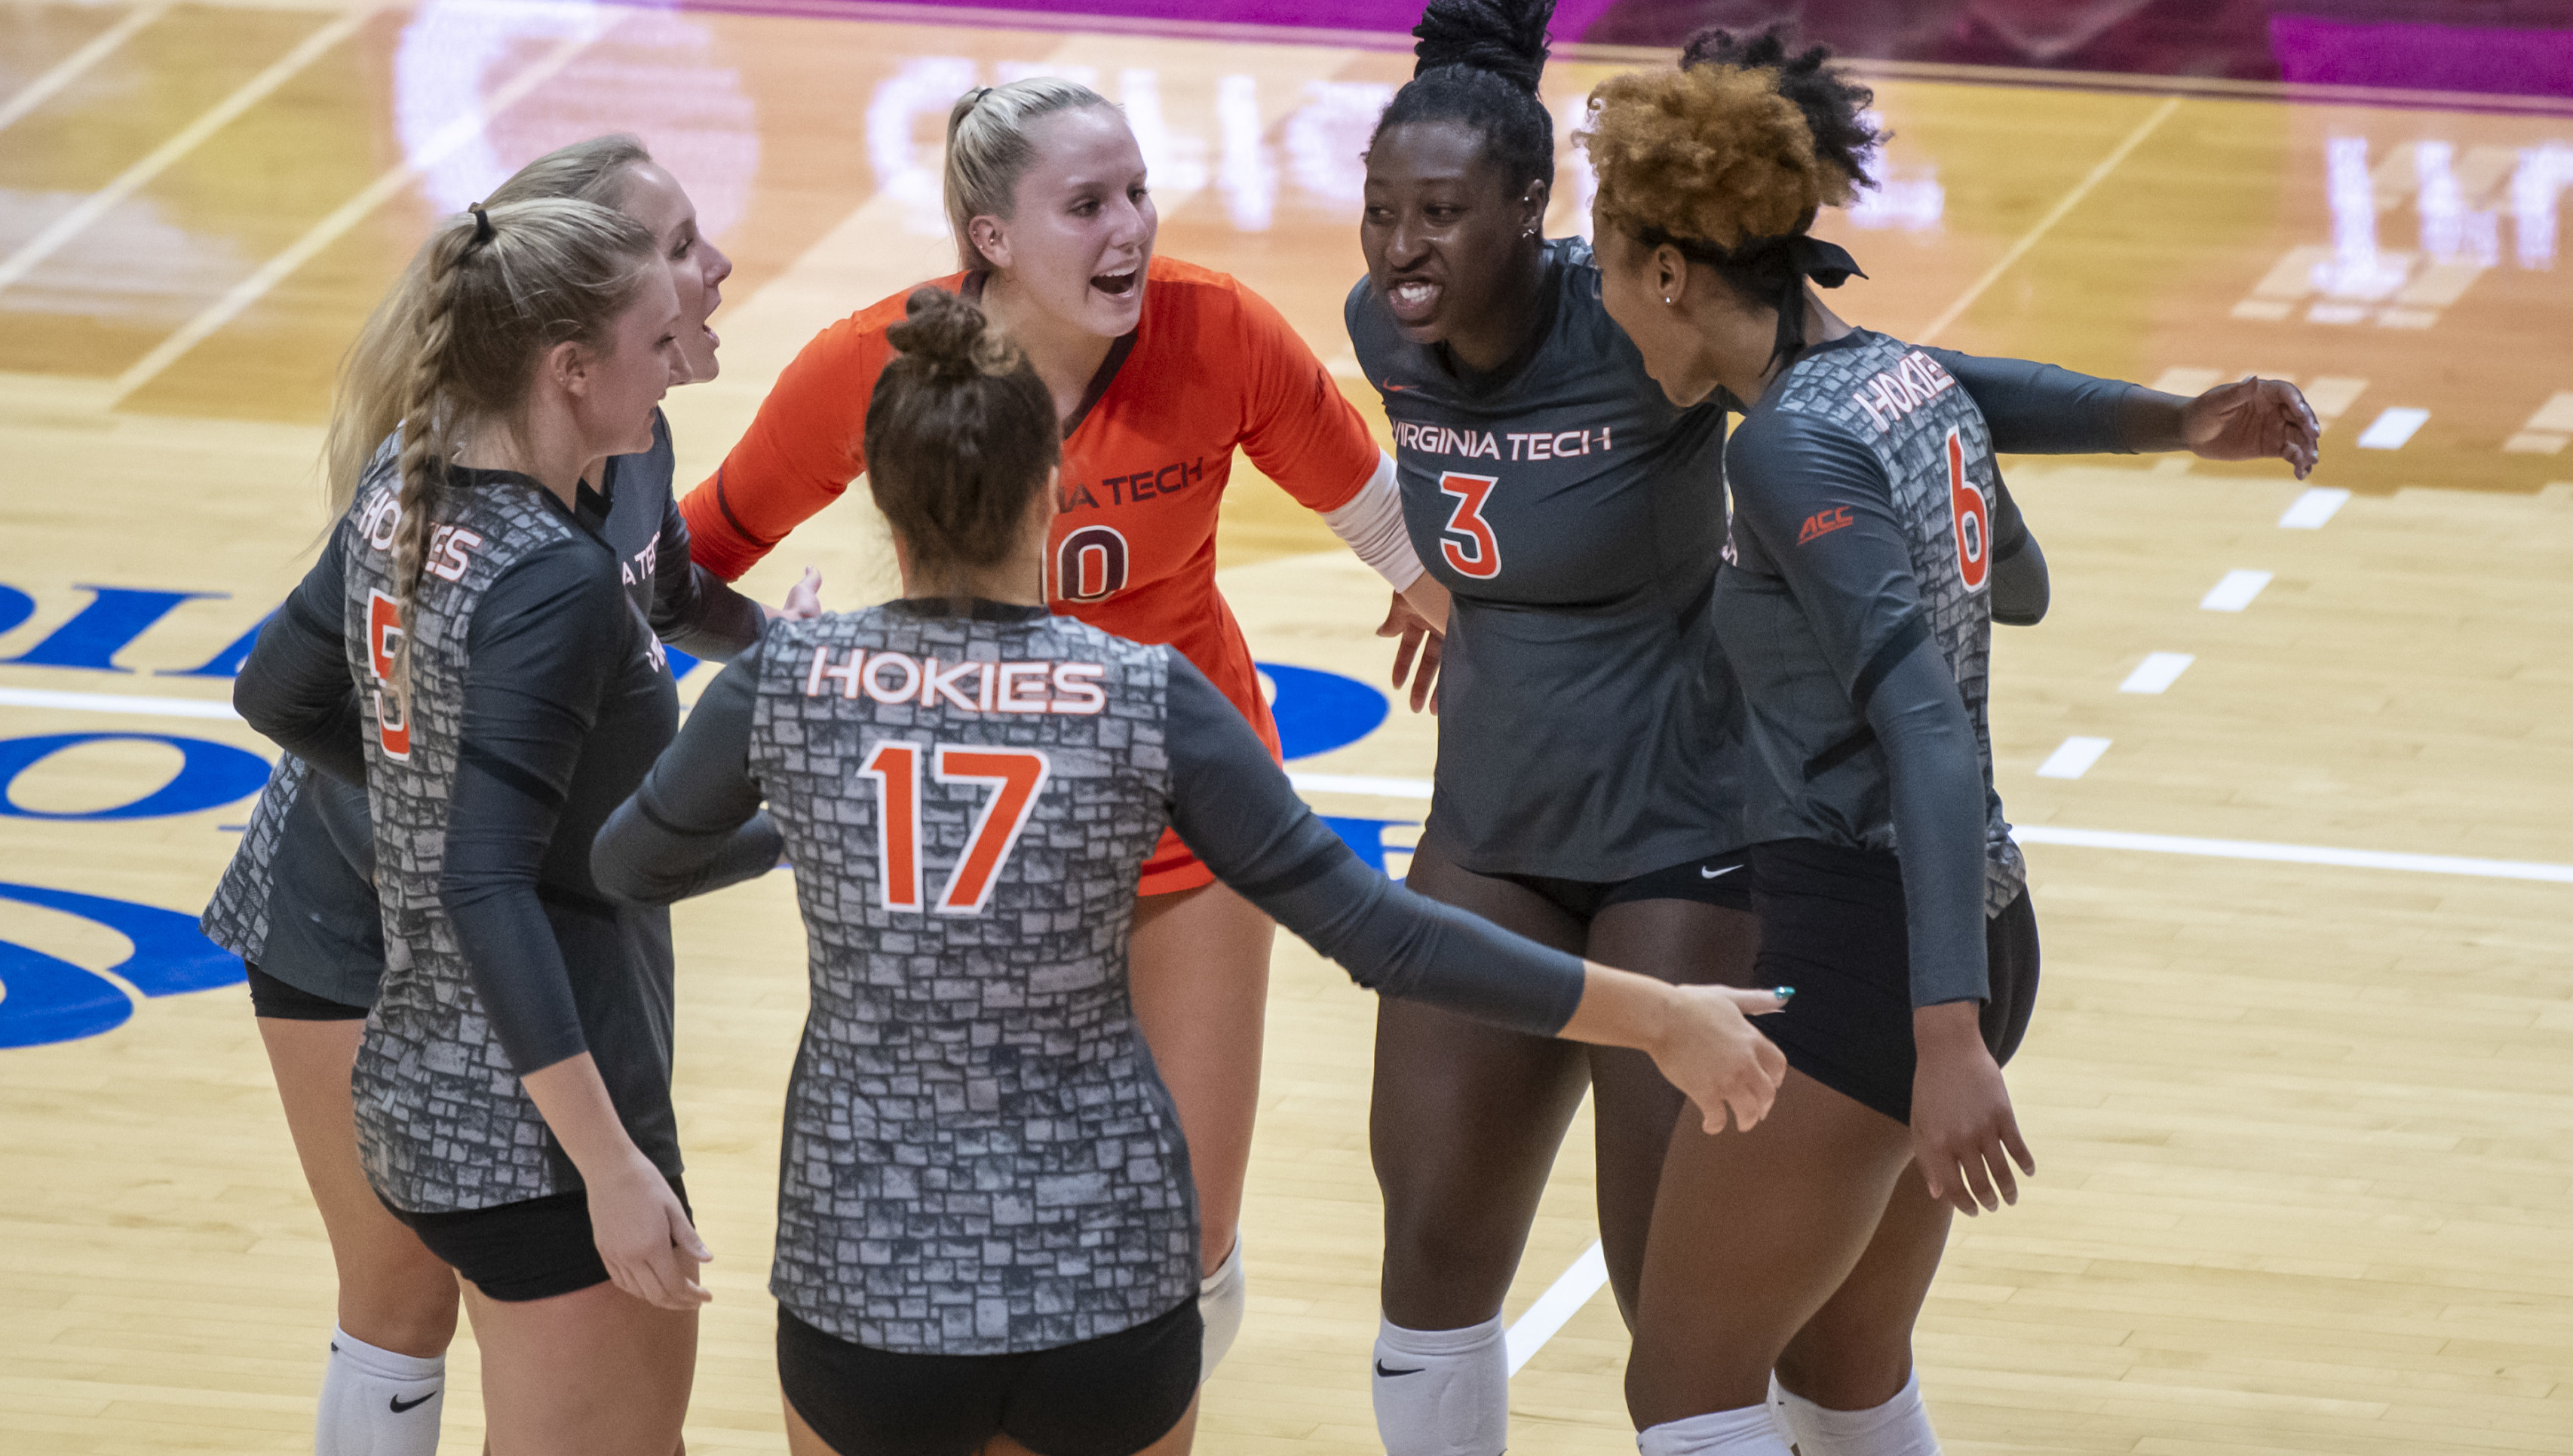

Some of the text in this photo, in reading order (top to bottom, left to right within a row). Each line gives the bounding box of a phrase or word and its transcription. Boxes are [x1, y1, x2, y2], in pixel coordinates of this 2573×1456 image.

[1853, 350, 1955, 434] HOKIE
[1102, 456, 1203, 506] TECH
[1393, 419, 1611, 461] VIRGINIA TECH
[357, 487, 483, 582] HOES
[1439, 471, 1501, 579] 3
[1799, 506, 1854, 543] ACC
[1946, 424, 1989, 593] 6
[807, 646, 1106, 715] HOKIES
[856, 740, 1051, 915] 17
